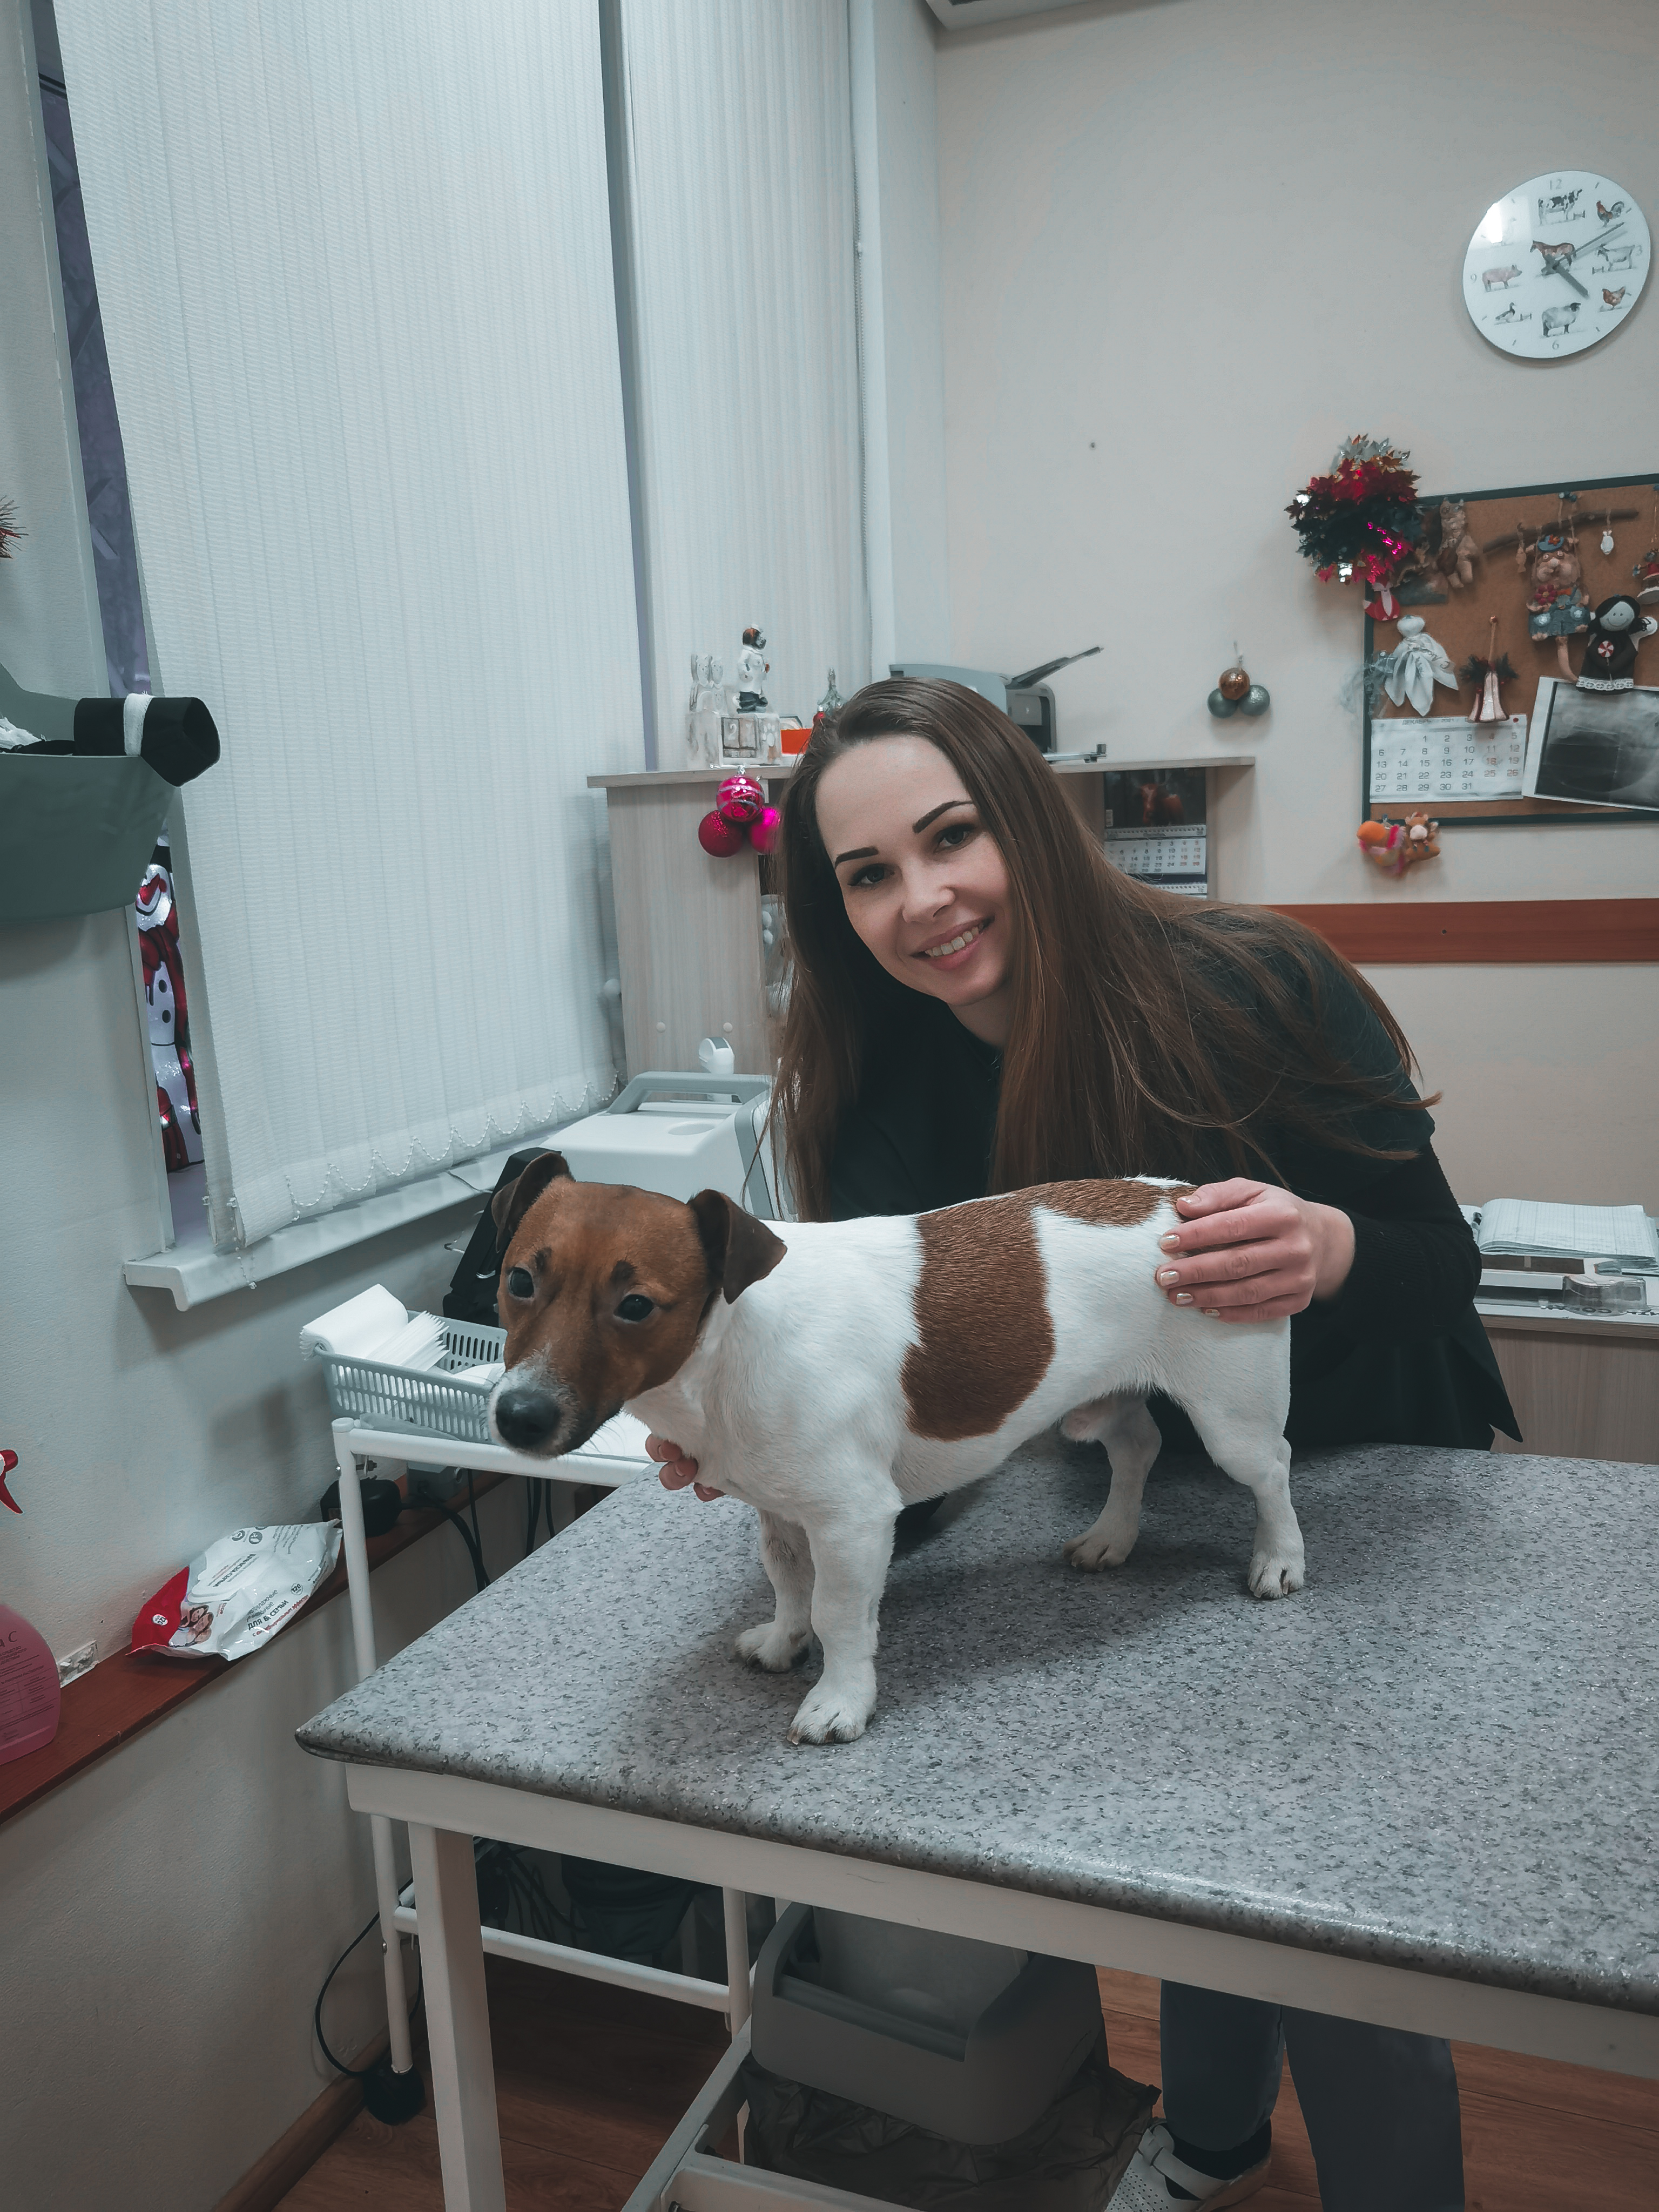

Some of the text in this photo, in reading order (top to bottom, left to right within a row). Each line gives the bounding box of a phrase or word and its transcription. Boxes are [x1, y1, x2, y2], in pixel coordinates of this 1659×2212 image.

[1549, 178, 1562, 190] 12
[1552, 340, 1560, 350] 6
[1511, 732, 1517, 740] 5
[1378, 748, 1385, 757] 6
[1464, 746, 1475, 754] 10
[1509, 744, 1520, 752] 12
[1462, 770, 1473, 778] 24
[1484, 770, 1496, 778] 25
[1507, 769, 1519, 777] 26
[247, 1618, 263, 1630] ДЛЯ
[269, 1600, 289, 1617] СЕМЬИ
